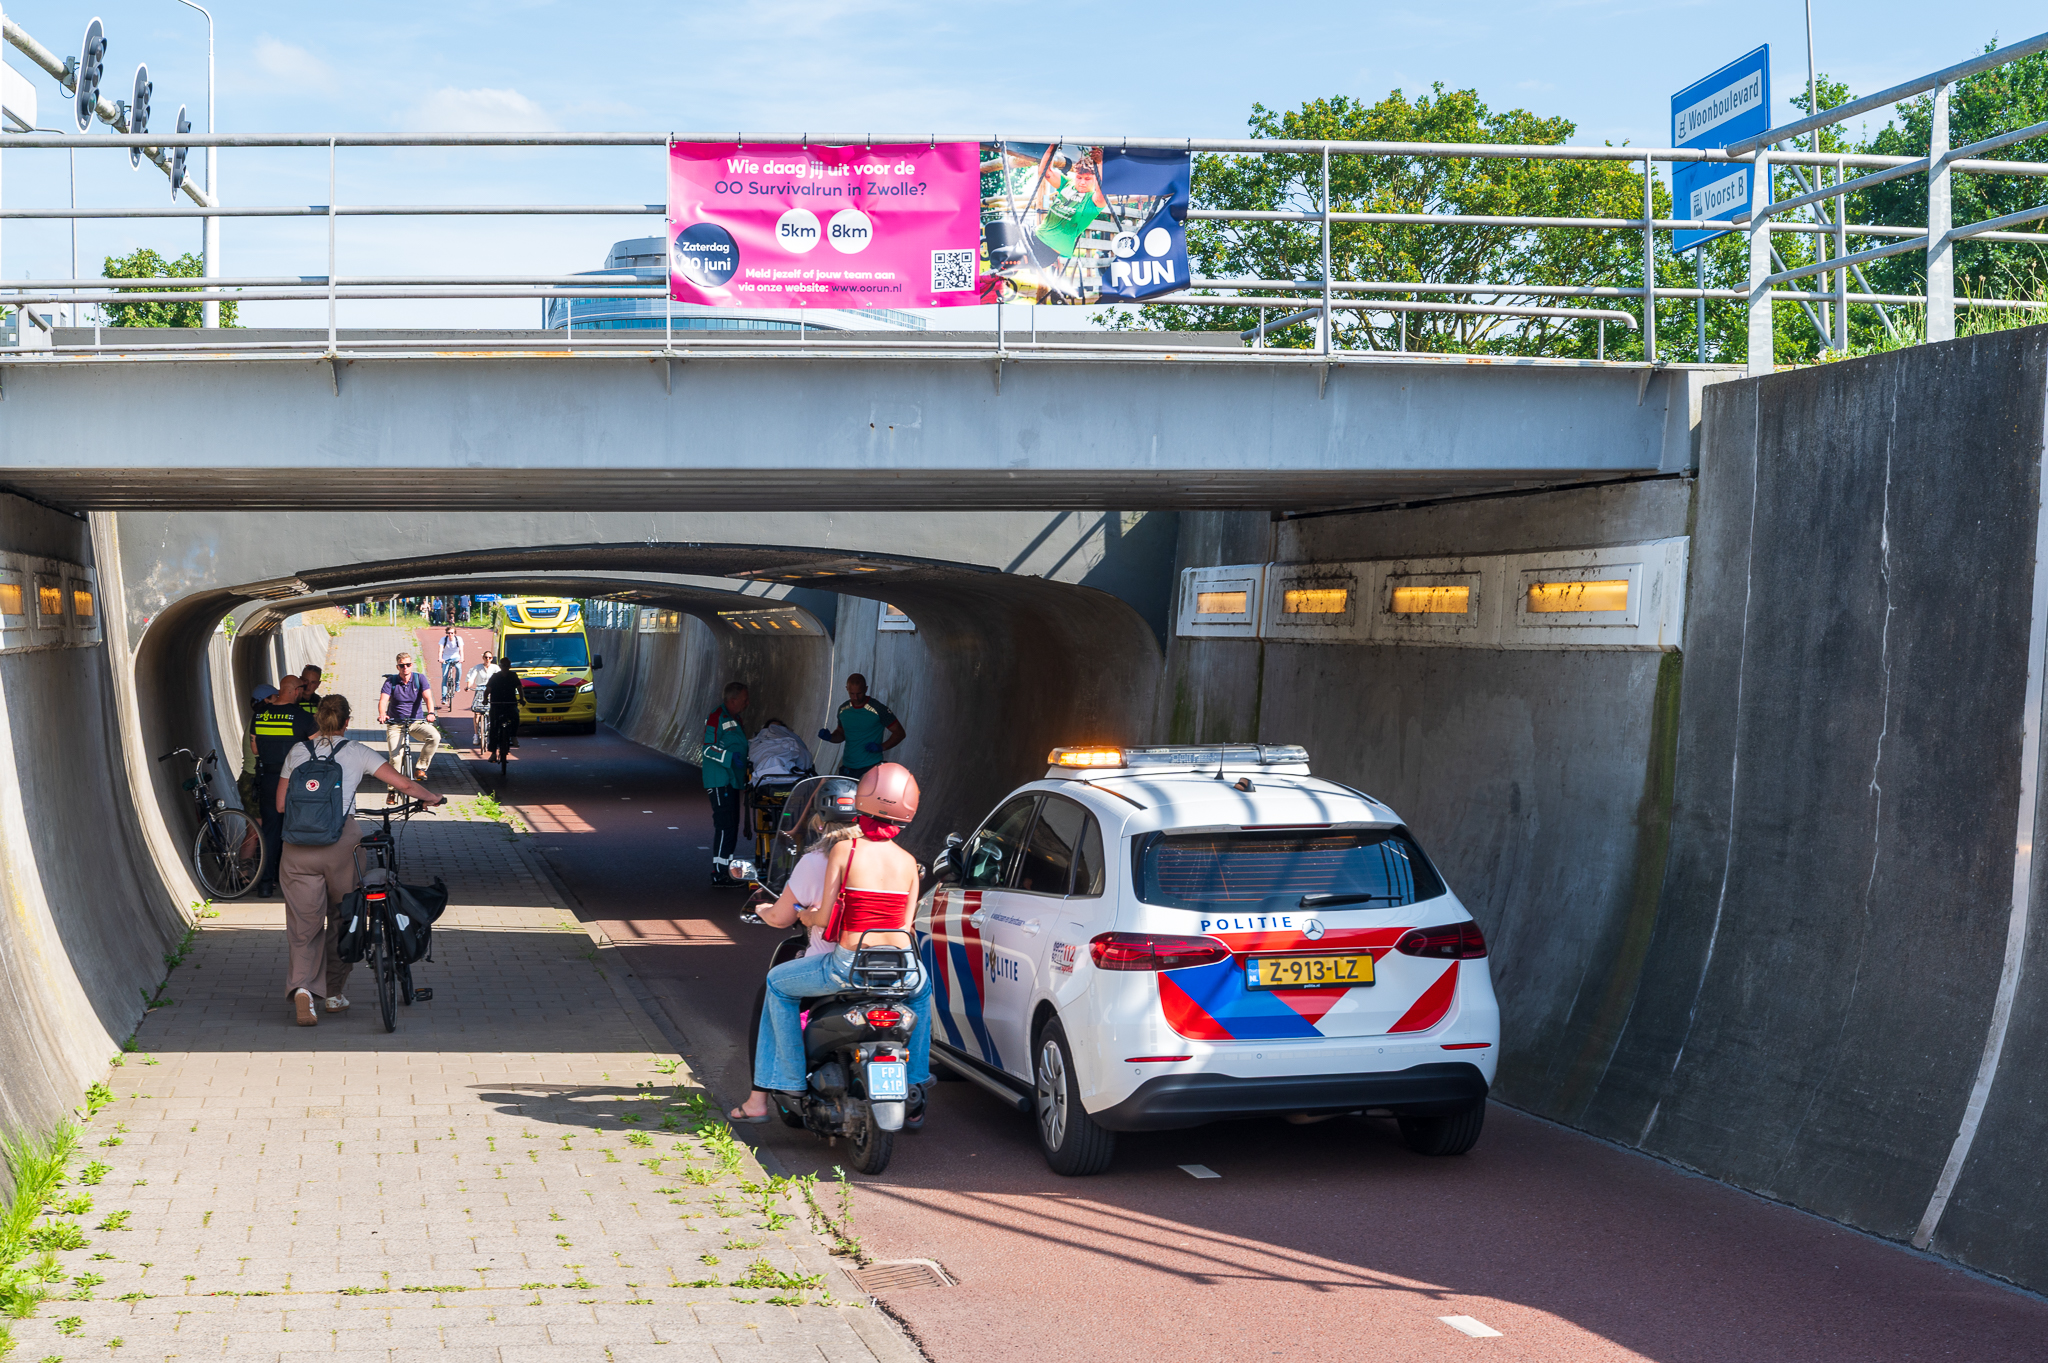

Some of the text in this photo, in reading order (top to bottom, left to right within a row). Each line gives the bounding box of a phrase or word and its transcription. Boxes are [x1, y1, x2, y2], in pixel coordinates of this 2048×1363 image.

[1688, 76, 1759, 131] Woonboulevard
[727, 159, 915, 179] Wie daag jij uit voor de
[714, 181, 927, 196] OO Survivalrun in Zwolle?
[1704, 175, 1744, 210] Voorst B
[781, 223, 816, 238] 5km
[832, 224, 868, 238] 8km
[682, 241, 730, 254] Zaterdag
[704, 257, 731, 274] juni
[1111, 259, 1176, 287] RUN
[745, 268, 895, 281] Meld jezelf of jouw team aan
[738, 282, 902, 293] via onze website: www.oorun.nl
[1200, 916, 1292, 932] POLITIE
[1063, 944, 1076, 962] 112
[985, 951, 1018, 983] POLITIE
[1270, 960, 1358, 982] Z-913-LZ
[881, 1066, 902, 1079] FPJ
[881, 1079, 903, 1091] 41P
